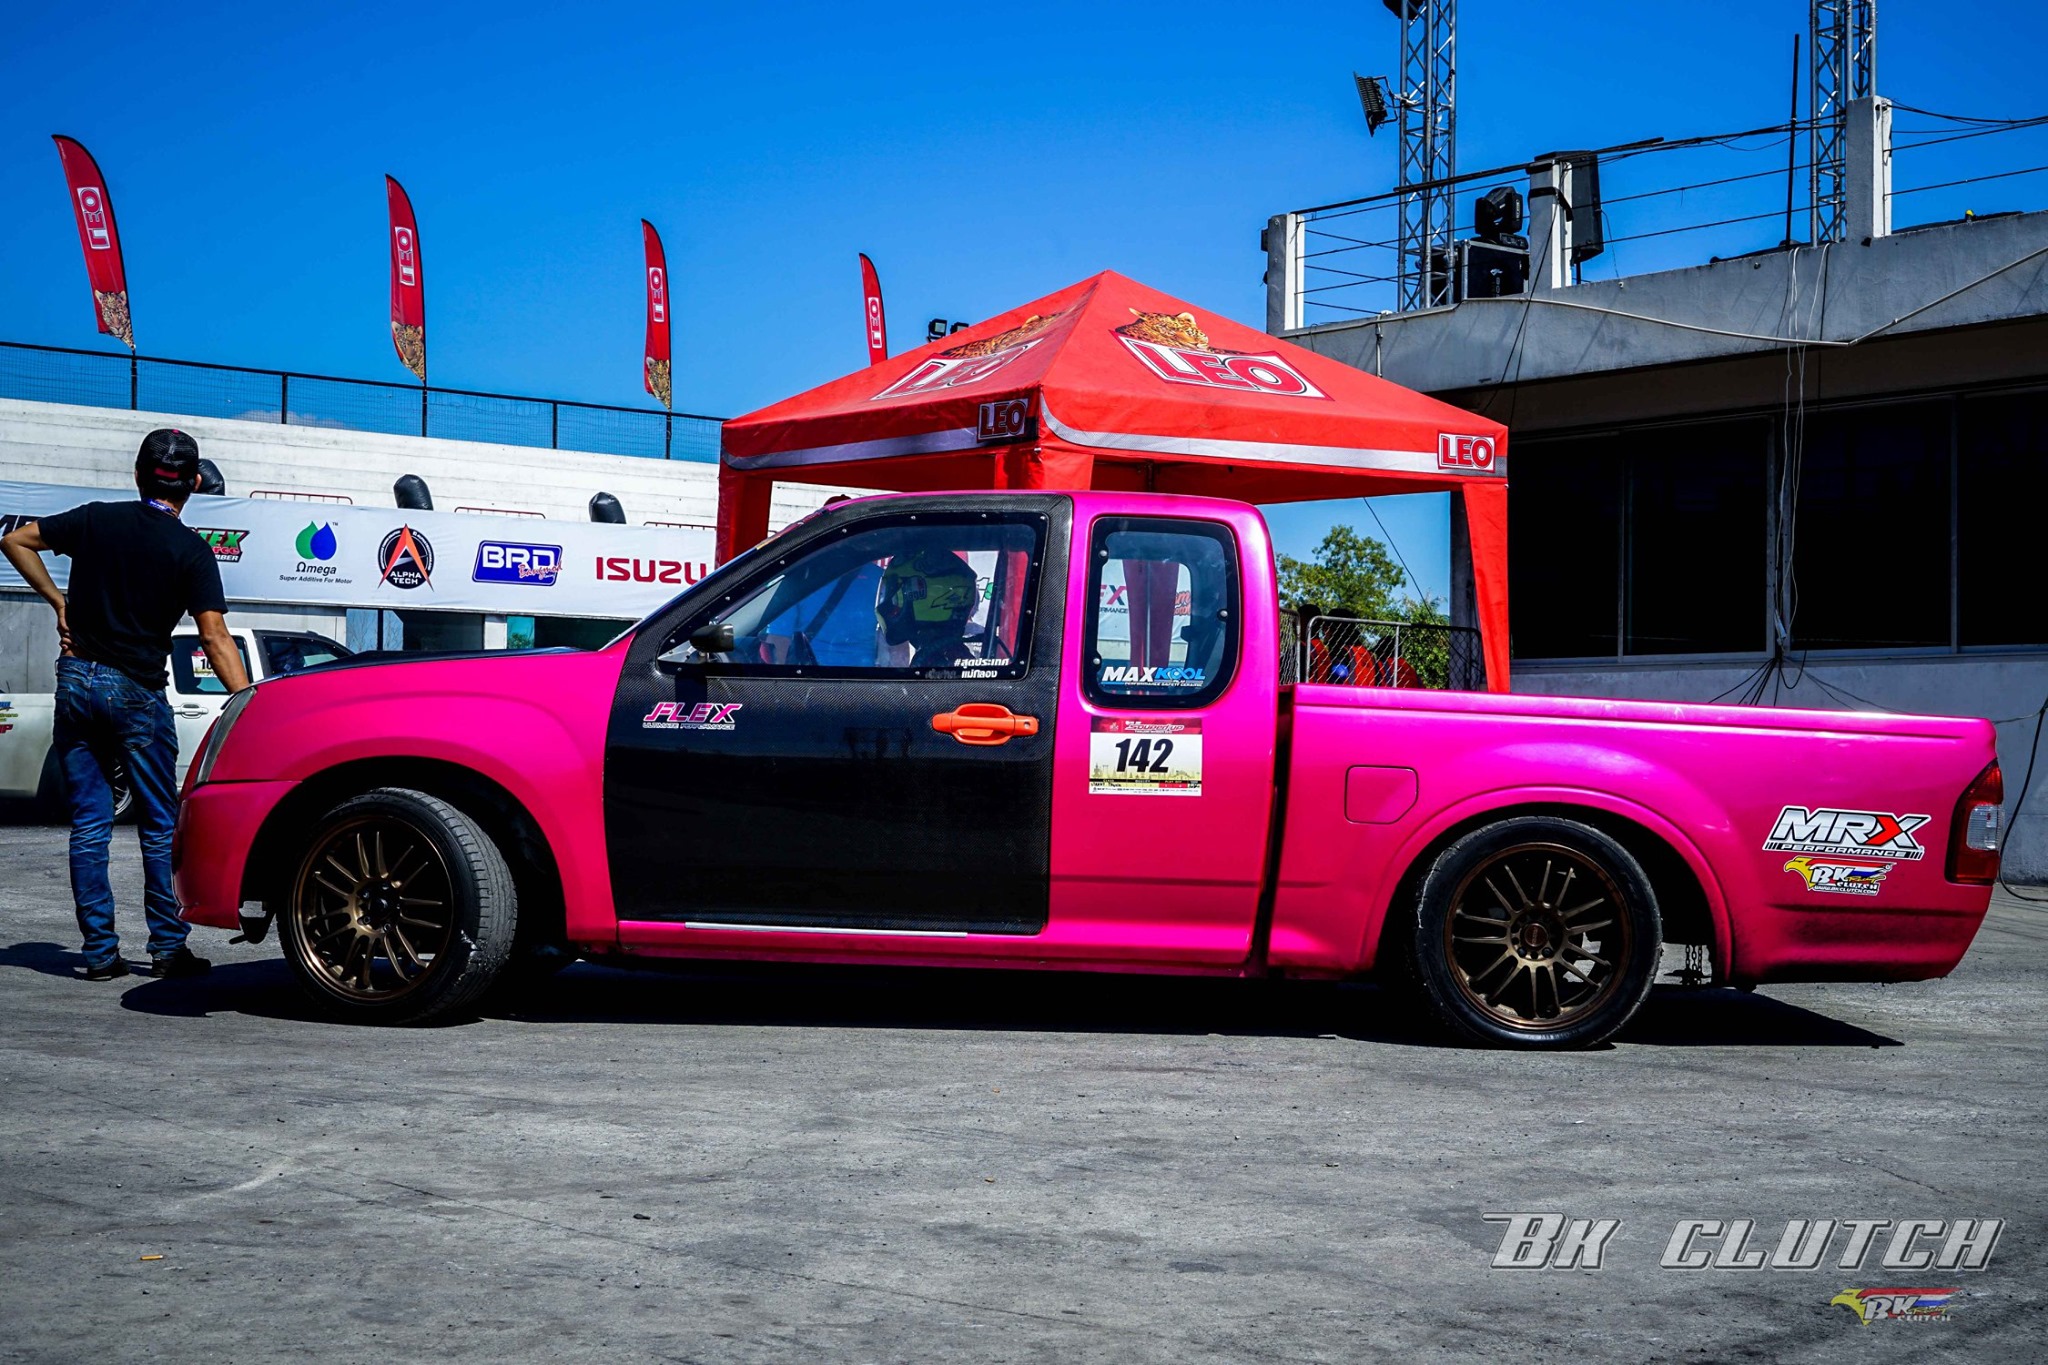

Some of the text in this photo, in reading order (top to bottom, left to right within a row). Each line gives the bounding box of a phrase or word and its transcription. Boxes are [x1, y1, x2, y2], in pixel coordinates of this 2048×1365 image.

[78, 188, 110, 248] LEO
[396, 228, 414, 284] LEO
[650, 268, 663, 321] LEO
[869, 298, 881, 347] LEO
[1126, 339, 1308, 395] LEO
[979, 400, 1027, 438] LEO
[1440, 435, 1493, 468] LEO
[482, 545, 555, 571] BRD
[596, 557, 707, 585] ISUZU
[279, 574, 298, 582] Super
[299, 575, 323, 583] Additive
[390, 571, 422, 579] ALPHA
[393, 577, 418, 585] TECH
[643, 702, 743, 723] FLEX
[1115, 738, 1174, 773] 142
[1769, 807, 1930, 850] MRX
[1781, 843, 1907, 858] PERFORMANCE
[1810, 866, 1854, 884] BK
[1836, 881, 1878, 890] CLUTCH
